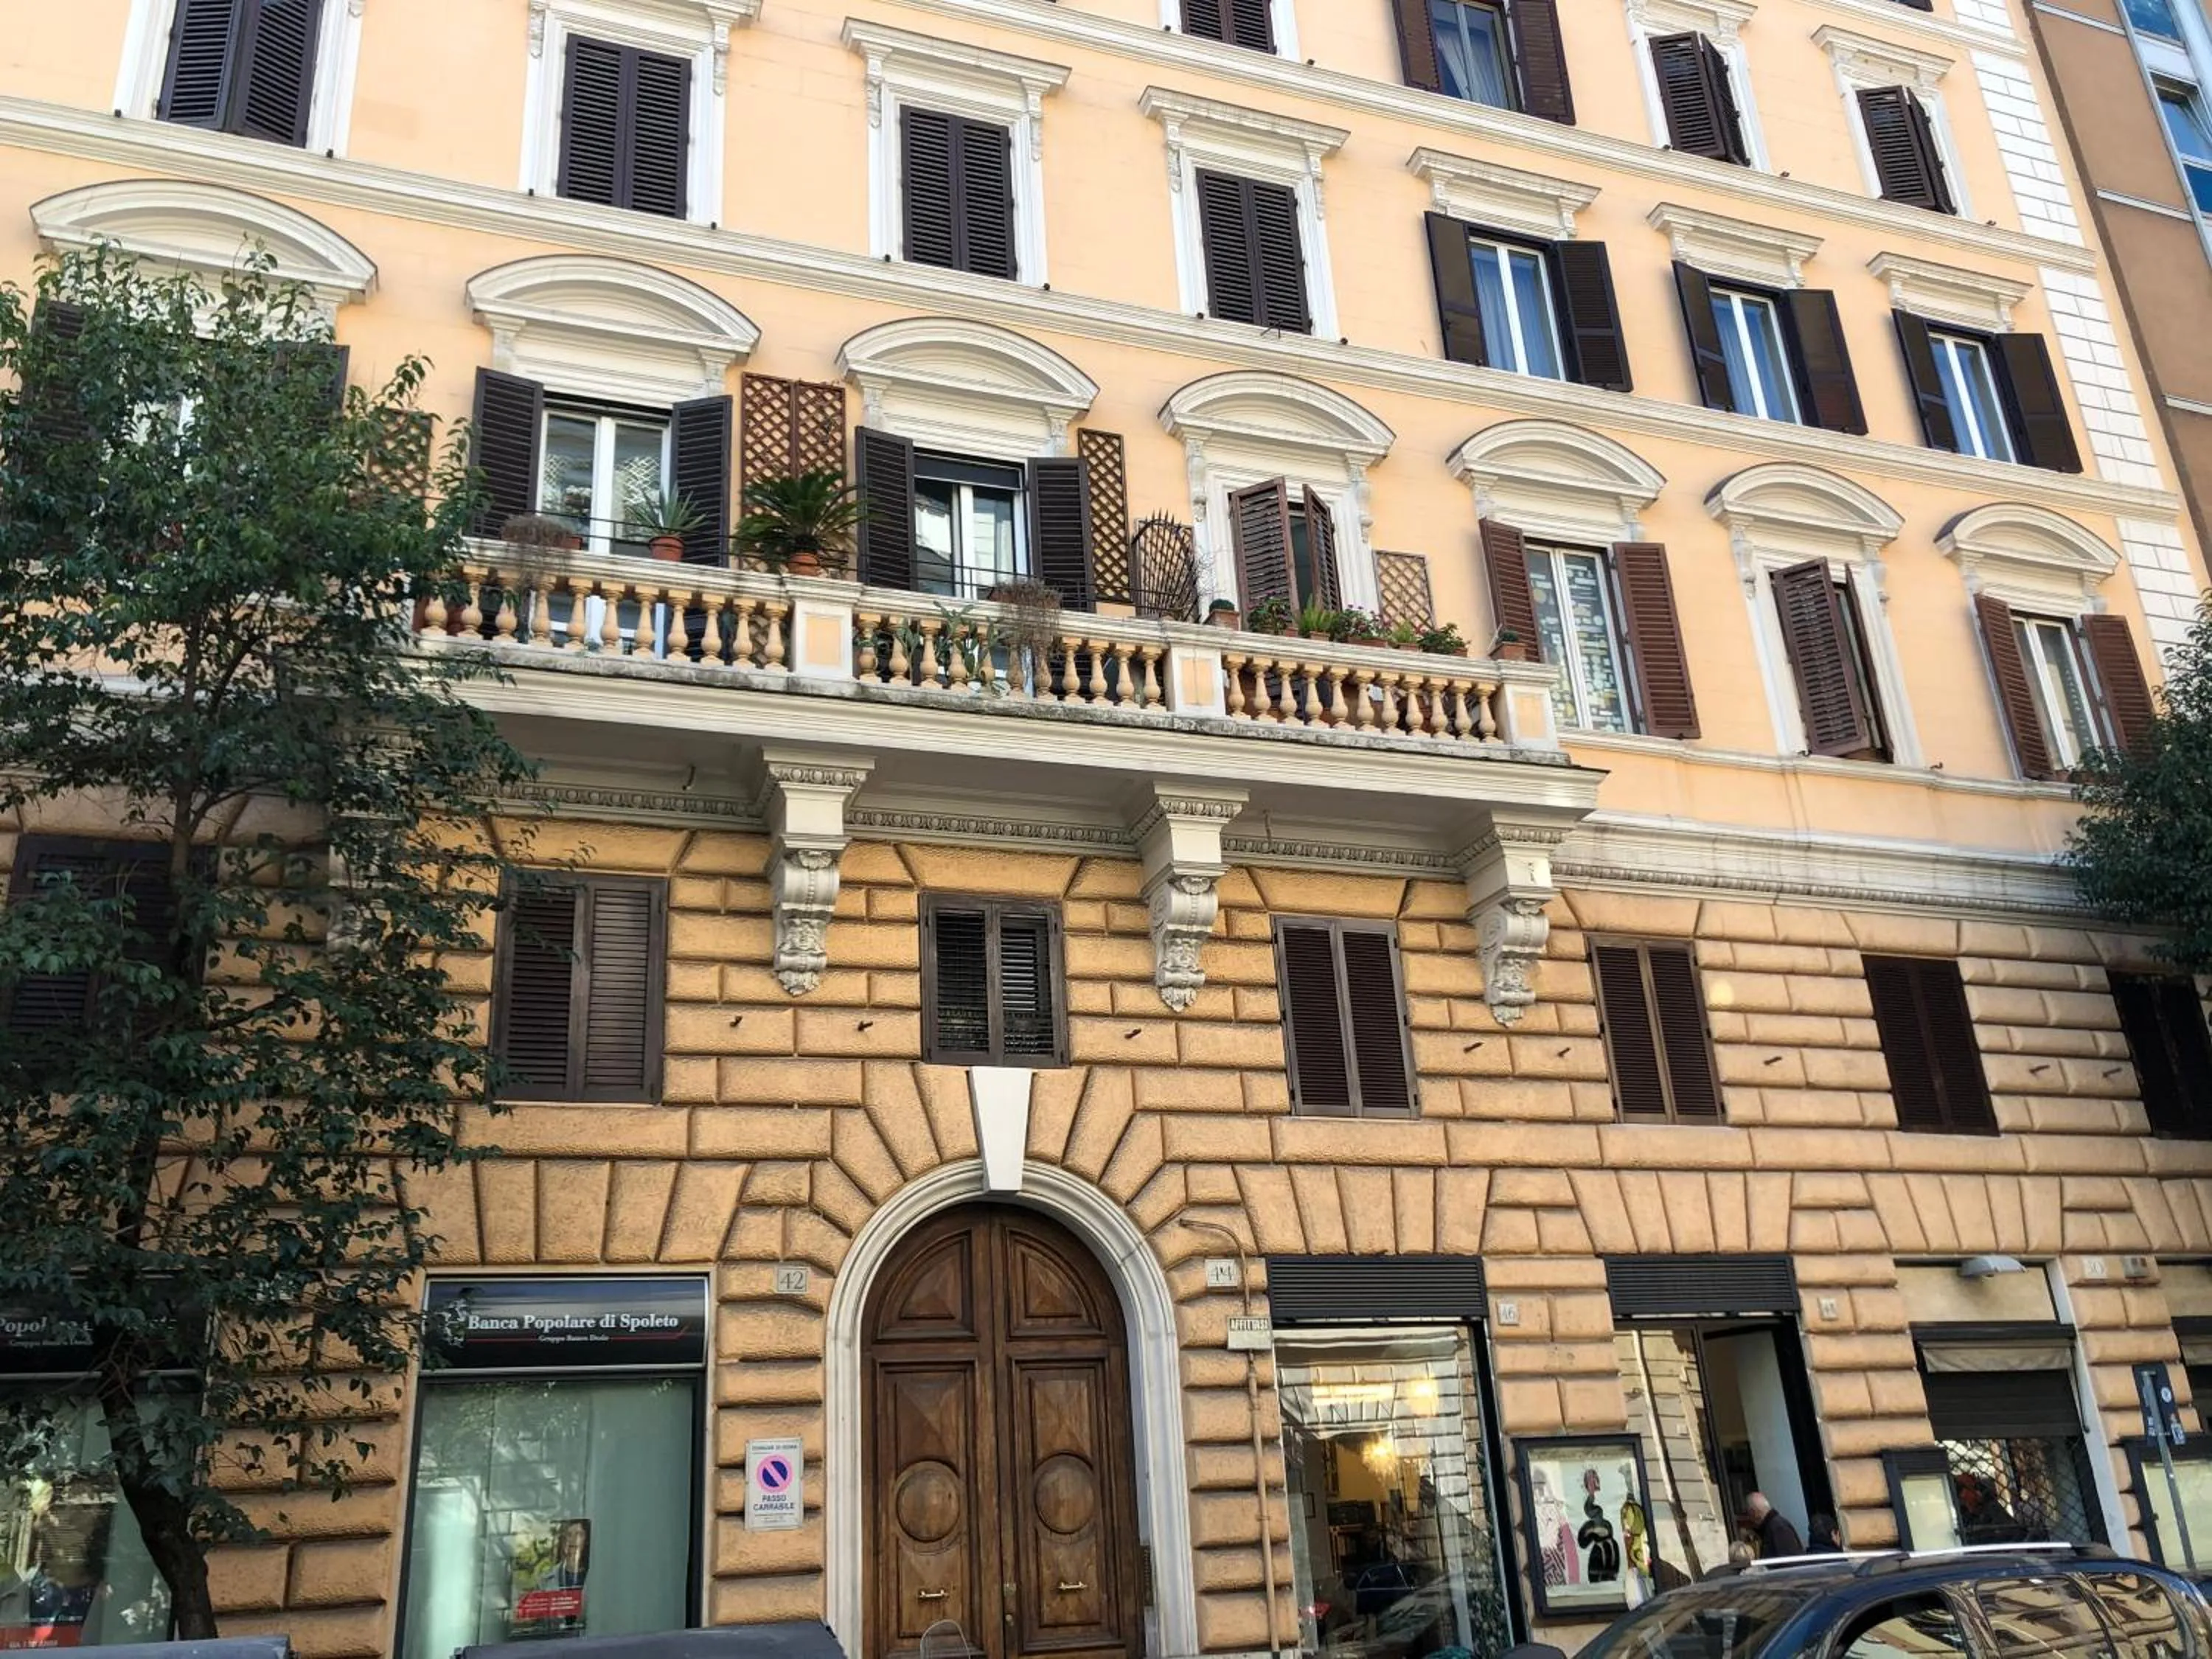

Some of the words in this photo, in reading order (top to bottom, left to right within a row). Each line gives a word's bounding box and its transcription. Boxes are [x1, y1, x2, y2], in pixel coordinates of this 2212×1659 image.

[780, 1270, 804, 1290] 42
[467, 1315, 518, 1330] Banca
[523, 1314, 597, 1334] Popolare
[599, 1313, 616, 1328] di
[620, 1312, 679, 1332] Spoleto
[753, 1503, 795, 1511] CARRABILE
